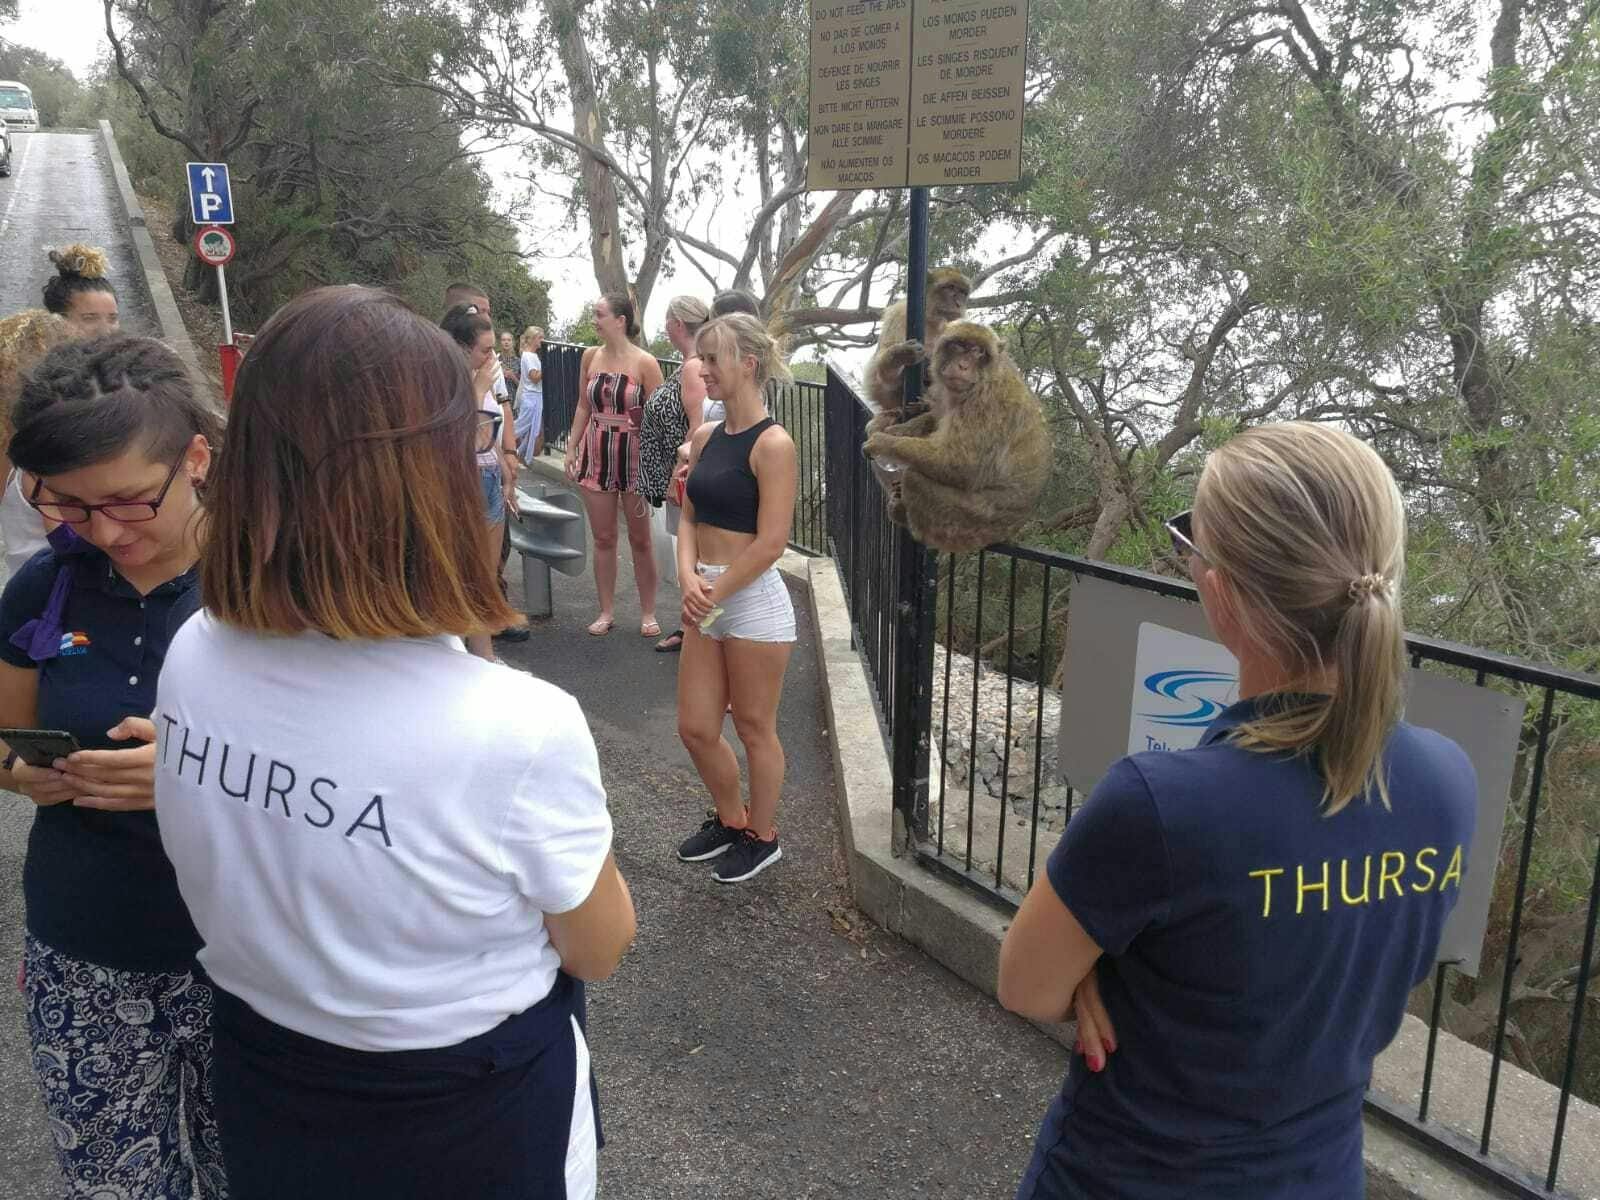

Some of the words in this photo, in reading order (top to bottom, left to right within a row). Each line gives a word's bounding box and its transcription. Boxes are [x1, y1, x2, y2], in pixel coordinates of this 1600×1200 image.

[815, 9, 827, 20] DO
[829, 7, 844, 18] NOT
[847, 4, 865, 15] FEED
[869, 1, 884, 12] THE
[922, 16, 940, 28] LOS
[943, 10, 976, 25] MONOS
[980, 6, 1017, 20] PUEDEN
[820, 31, 831, 41] NO
[833, 29, 848, 40] DAR
[850, 26, 861, 38] DE
[864, 23, 891, 35] COMER
[894, 22, 900, 33] A
[949, 26, 987, 40] MORDER
[833, 46, 838, 56] A
[841, 43, 855, 54] LOS
[858, 39, 887, 52] MONOS
[917, 55, 934, 67] LES
[937, 51, 970, 65] SINGES
[973, 46, 1019, 61] RISQUENT
[818, 65, 852, 78] DEFENSE
[854, 63, 864, 74] DE
[867, 59, 900, 72] NOURRIR
[940, 69, 951, 80] DE
[956, 64, 993, 79] MORDRE
[836, 80, 850, 91] LES
[853, 77, 880, 89] SINGES
[922, 93, 937, 104] DIE
[941, 91, 968, 103] AFFEN
[971, 86, 1010, 100] BEISSEN
[818, 103, 838, 114] BITTE
[840, 100, 863, 112] NICHT
[916, 117, 926, 128] LE
[930, 113, 967, 127] SCIMMIE
[970, 110, 1015, 123] POSSONO
[814, 124, 829, 136] NON
[831, 122, 850, 133] DARE
[853, 121, 863, 132] DA
[943, 128, 985, 140] MORDERE
[832, 137, 848, 148] ALLE
[852, 135, 884, 146] SCIMMIE
[838, 156, 880, 168] ALIMENTEM
[882, 156, 894, 166] OS
[916, 153, 929, 164] OS
[933, 151, 975, 163] MACACOS
[979, 149, 1012, 161] PODEM
[837, 172, 874, 183] MACACOS
[944, 166, 981, 178] MORDER
[200, 193, 223, 220] P
[162, 713, 393, 848] THURSA
[1248, 844, 1462, 918] THURSA
